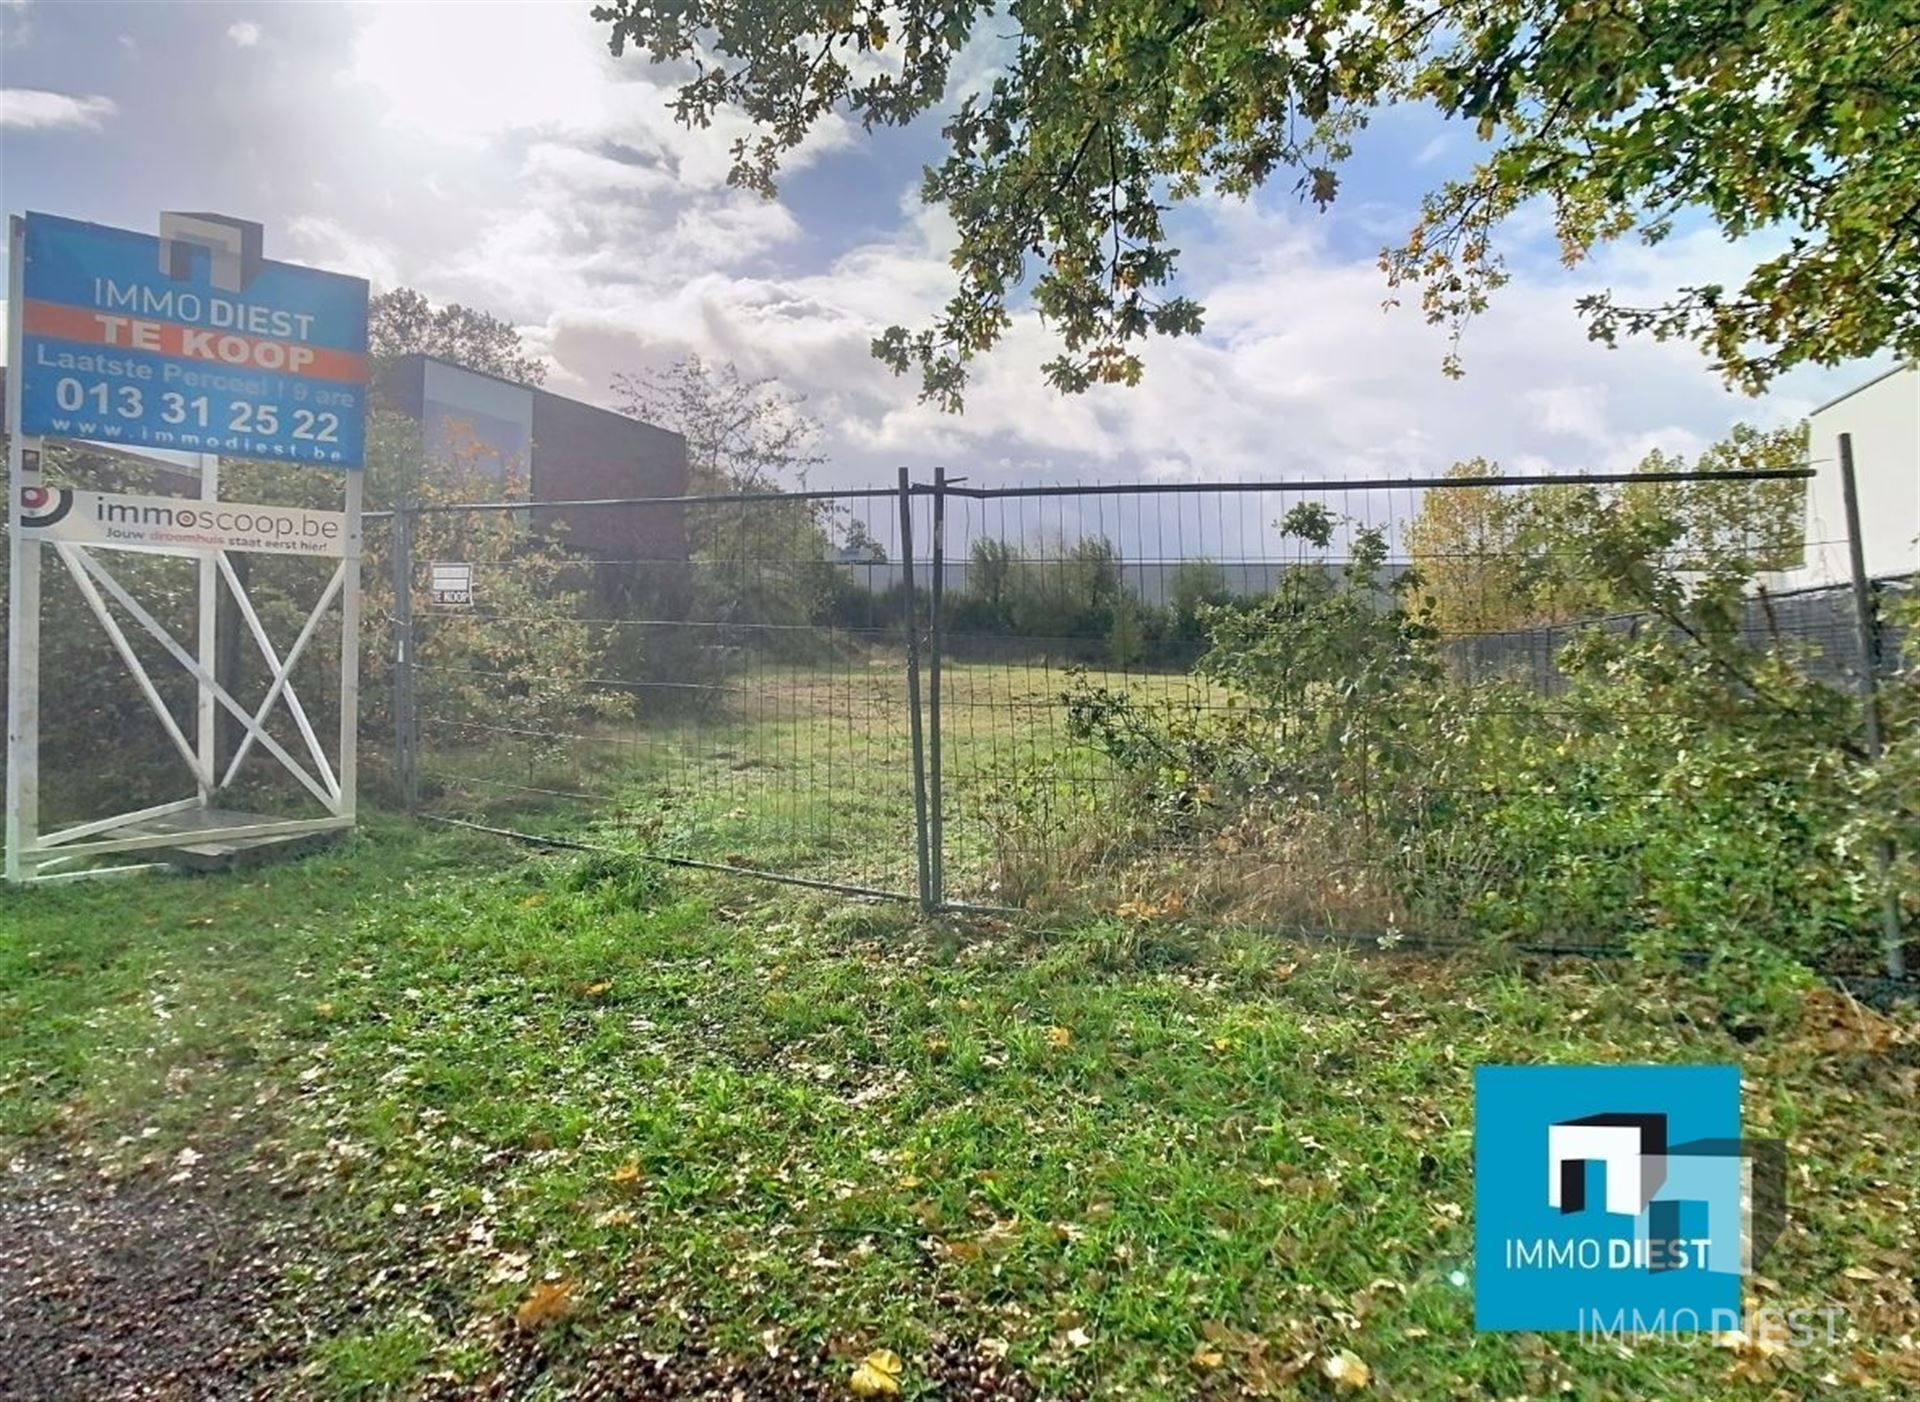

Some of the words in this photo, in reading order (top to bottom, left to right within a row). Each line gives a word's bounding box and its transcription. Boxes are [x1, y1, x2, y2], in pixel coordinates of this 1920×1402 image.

[95, 278, 200, 322] IMMO
[210, 299, 314, 340] DIEST
[95, 314, 162, 351] TE
[182, 329, 315, 373] KOOP
[37, 344, 153, 380] Laatste
[164, 363, 268, 396] Perceel
[316, 390, 355, 408] are
[52, 418, 341, 461] www.immodiest.be
[56, 377, 144, 419] 013
[161, 392, 209, 427] 31
[229, 401, 279, 435] 25
[292, 410, 339, 443] 22
[97, 496, 339, 540] immoscoop.be
[105, 527, 145, 541] Jouw
[150, 530, 225, 546] droomhuis
[228, 537, 262, 549] staat
[265, 539, 297, 550] eerst
[300, 540, 328, 552] hier!
